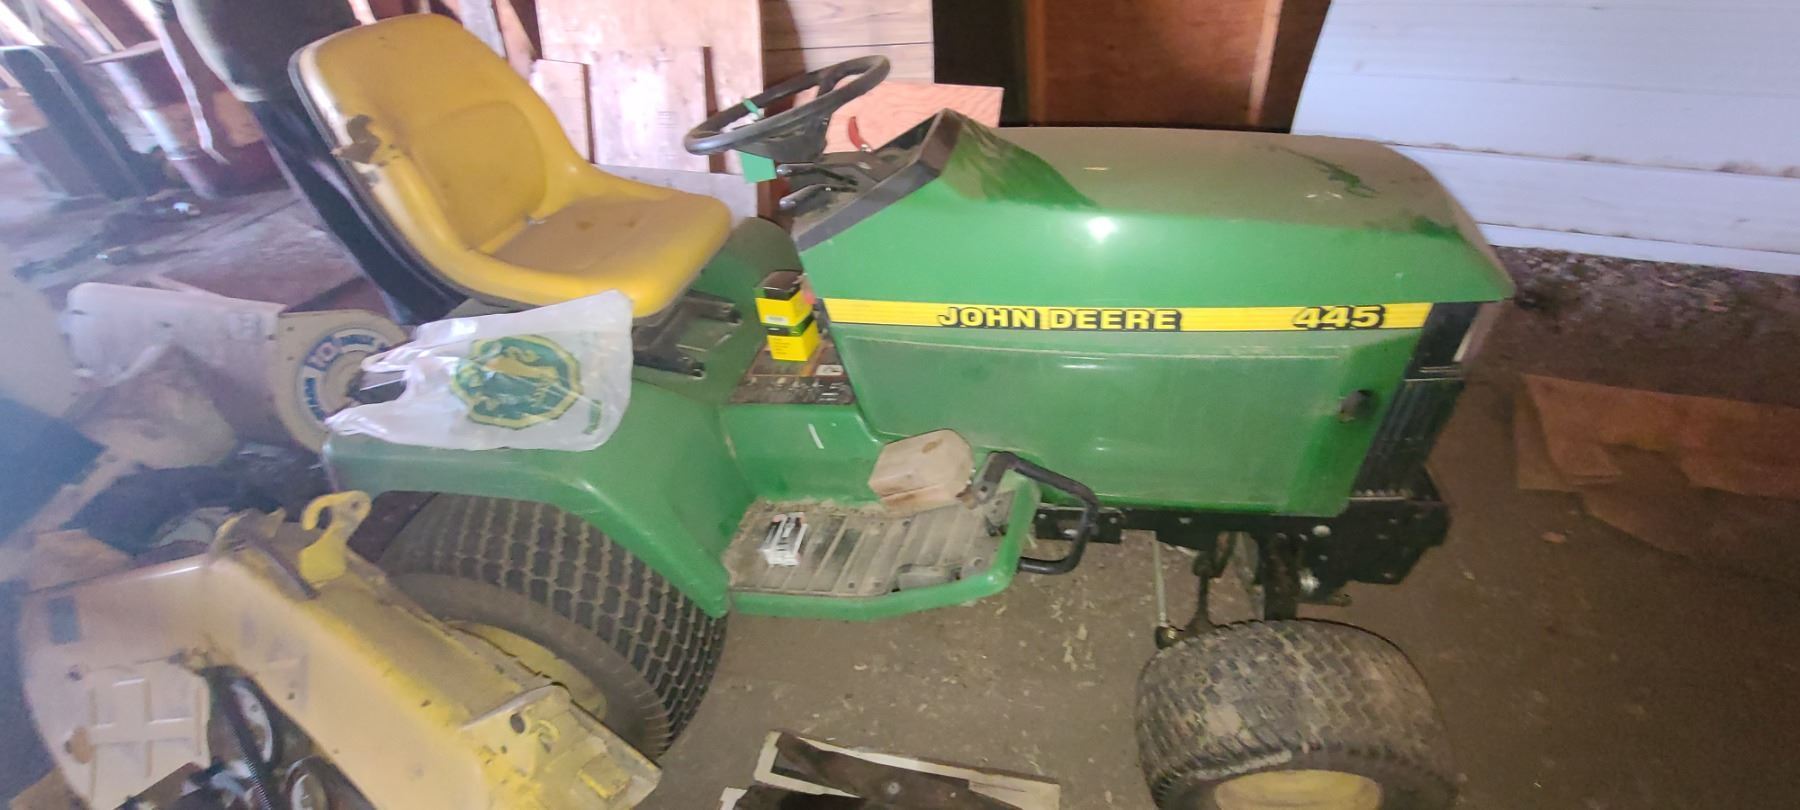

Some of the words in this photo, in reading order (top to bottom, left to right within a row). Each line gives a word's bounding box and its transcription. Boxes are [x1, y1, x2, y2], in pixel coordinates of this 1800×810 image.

[937, 307, 1038, 329] JOHN
[1049, 309, 1180, 331] DEERE
[1293, 305, 1383, 329] 445
